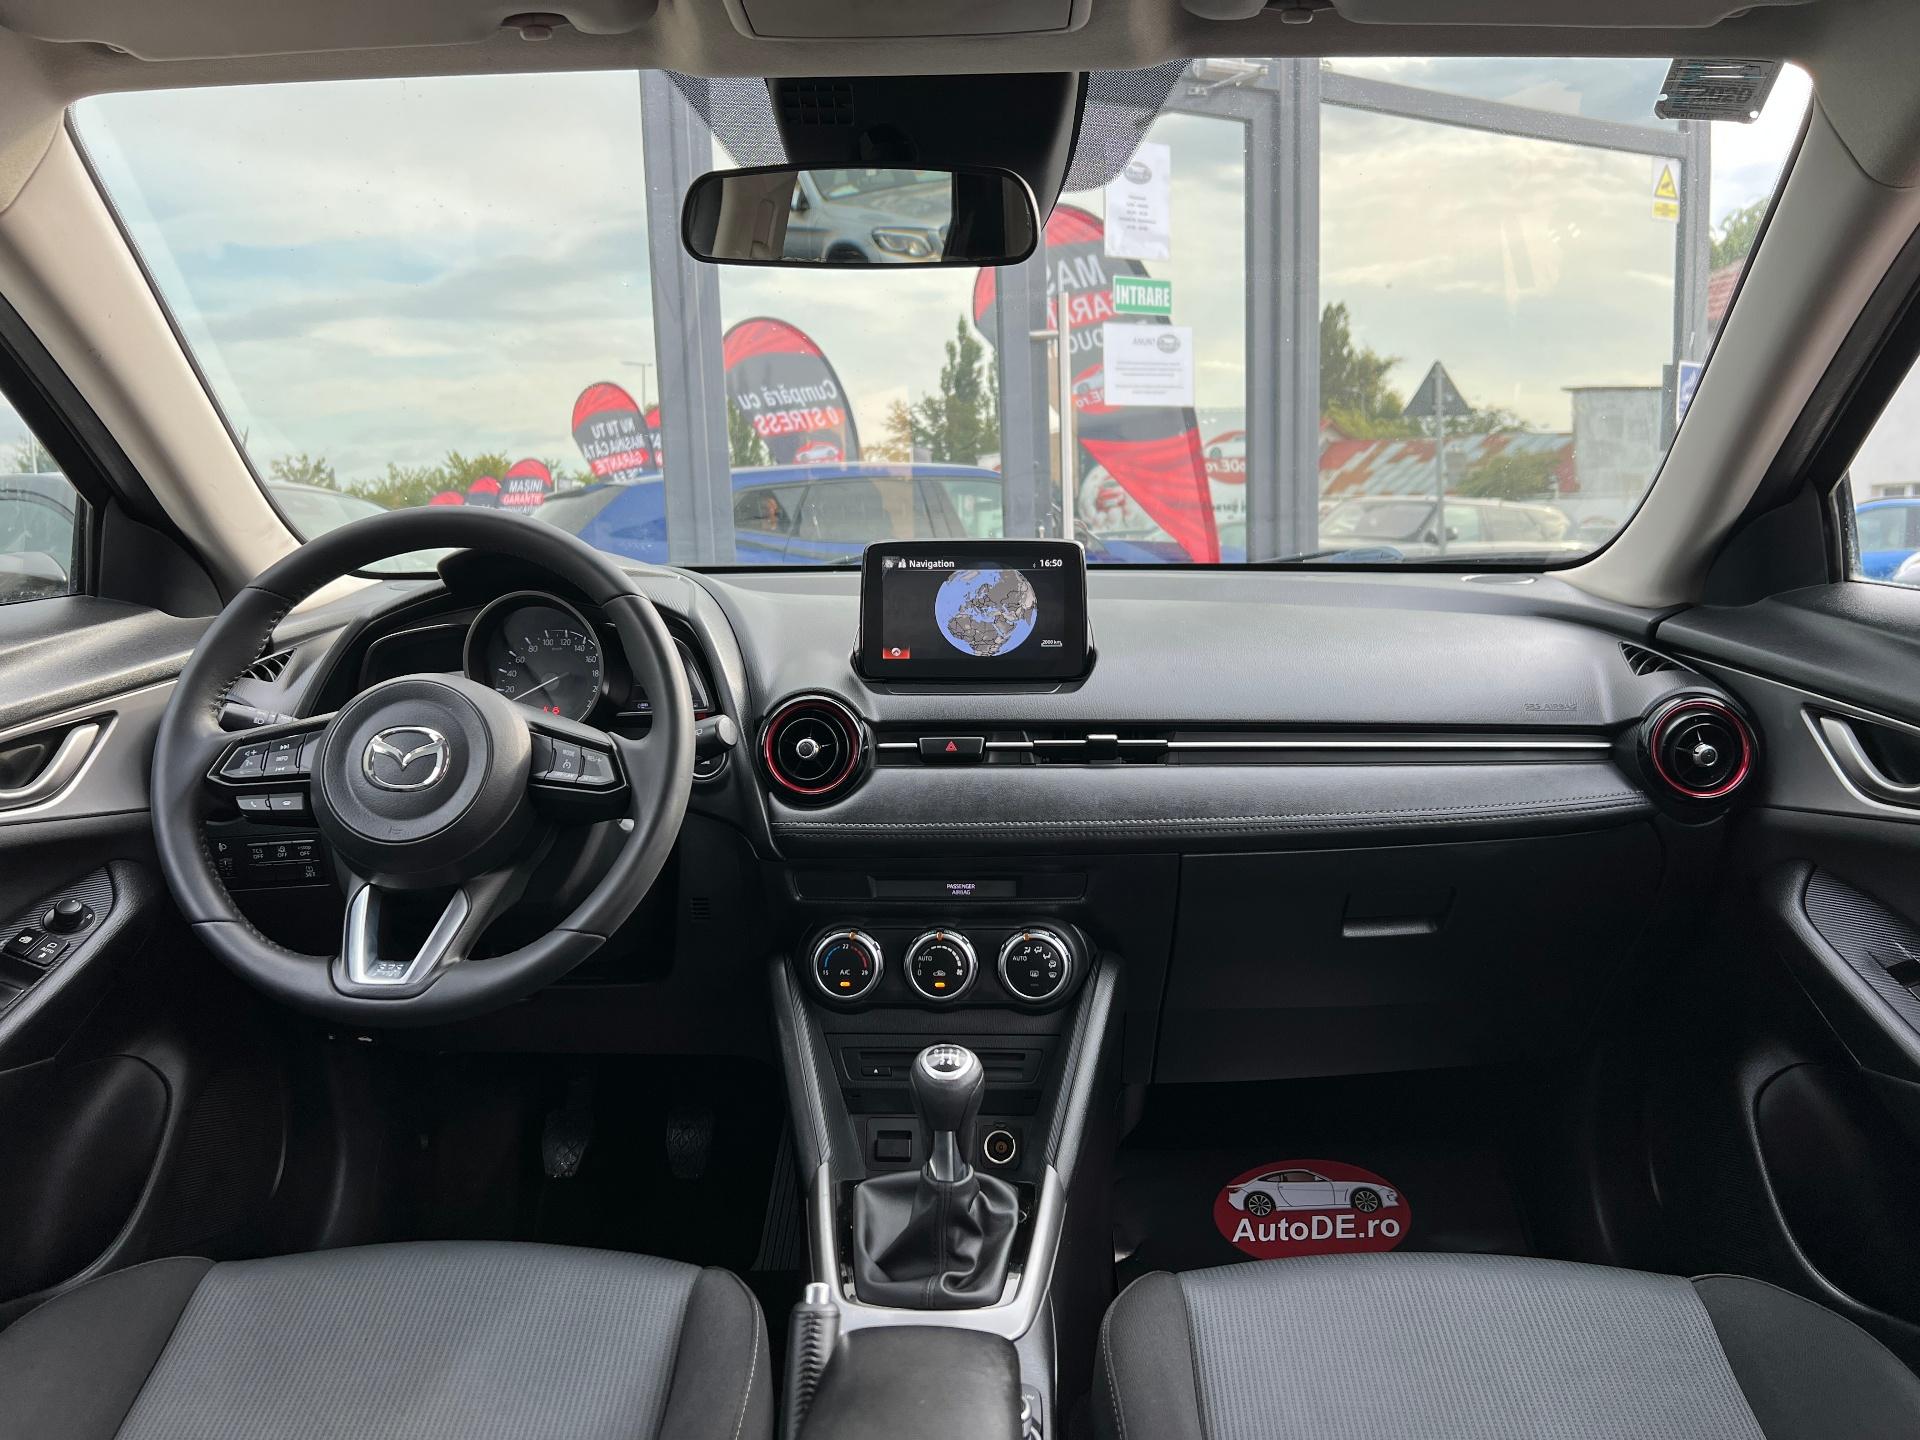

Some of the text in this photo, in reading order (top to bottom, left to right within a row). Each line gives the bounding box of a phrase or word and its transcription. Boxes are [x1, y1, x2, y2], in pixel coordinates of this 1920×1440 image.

[1116, 284, 1170, 308] INTRARE
[909, 559, 955, 569] Navigation
[1039, 559, 1062, 567] 16:50
[560, 638, 571, 646] 120
[528, 645, 538, 653] 80
[574, 644, 585, 652] 140
[516, 656, 525, 664] 60
[507, 670, 517, 678] 40
[505, 685, 515, 693] 20
[1232, 1214, 1400, 1243] AutoDE.ro
